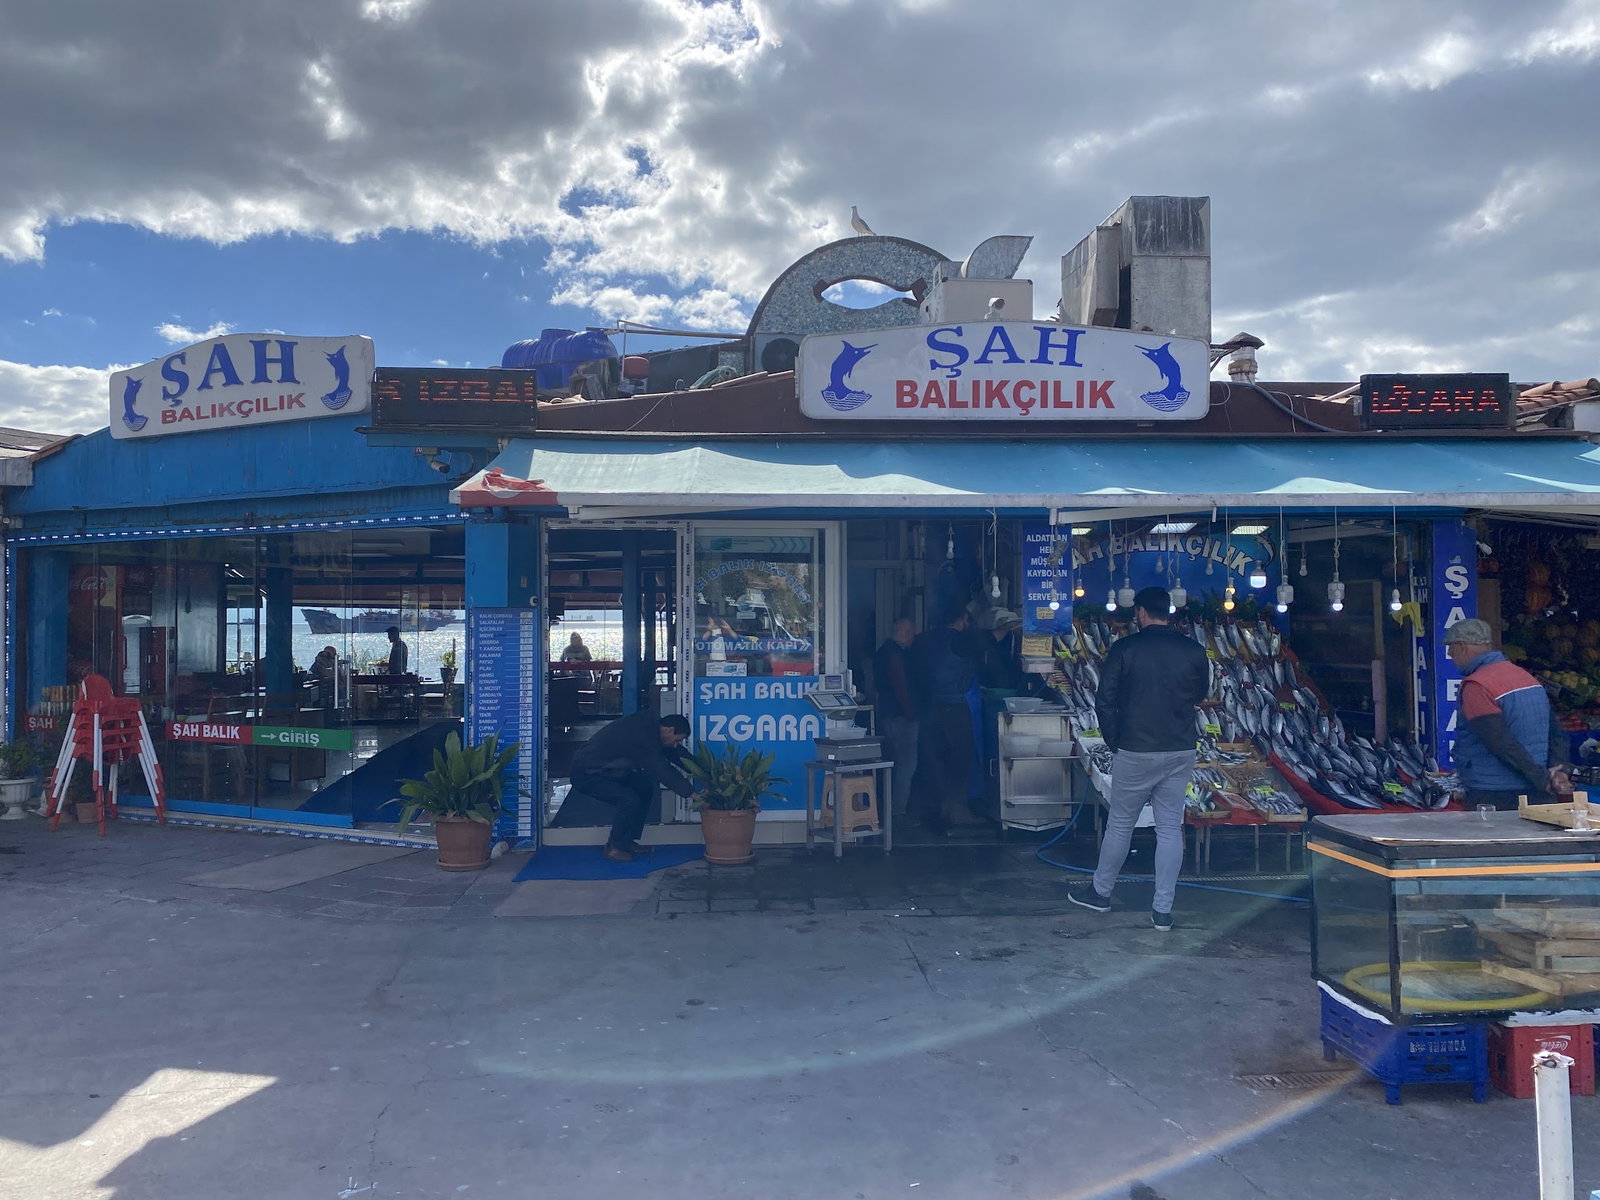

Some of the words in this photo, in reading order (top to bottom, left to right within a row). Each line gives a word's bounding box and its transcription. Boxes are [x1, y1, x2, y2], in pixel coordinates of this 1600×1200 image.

[927, 326, 1086, 378] ŞAH
[161, 339, 300, 408] ŞAH
[161, 392, 306, 425] BALIKÇILIK
[895, 379, 1116, 416] BALIKÇILIK
[1072, 543, 1104, 570] AH
[1110, 534, 1253, 577] BALIKÇILIK
[1028, 592, 1068, 601] SERVETİR
[700, 682, 747, 705] ŞAH
[755, 682, 820, 700] BALIK
[173, 723, 199, 739] ŞAH
[202, 724, 240, 739] BALIK
[279, 730, 320, 747] GİRİŞ
[699, 714, 820, 741] IZGARA
